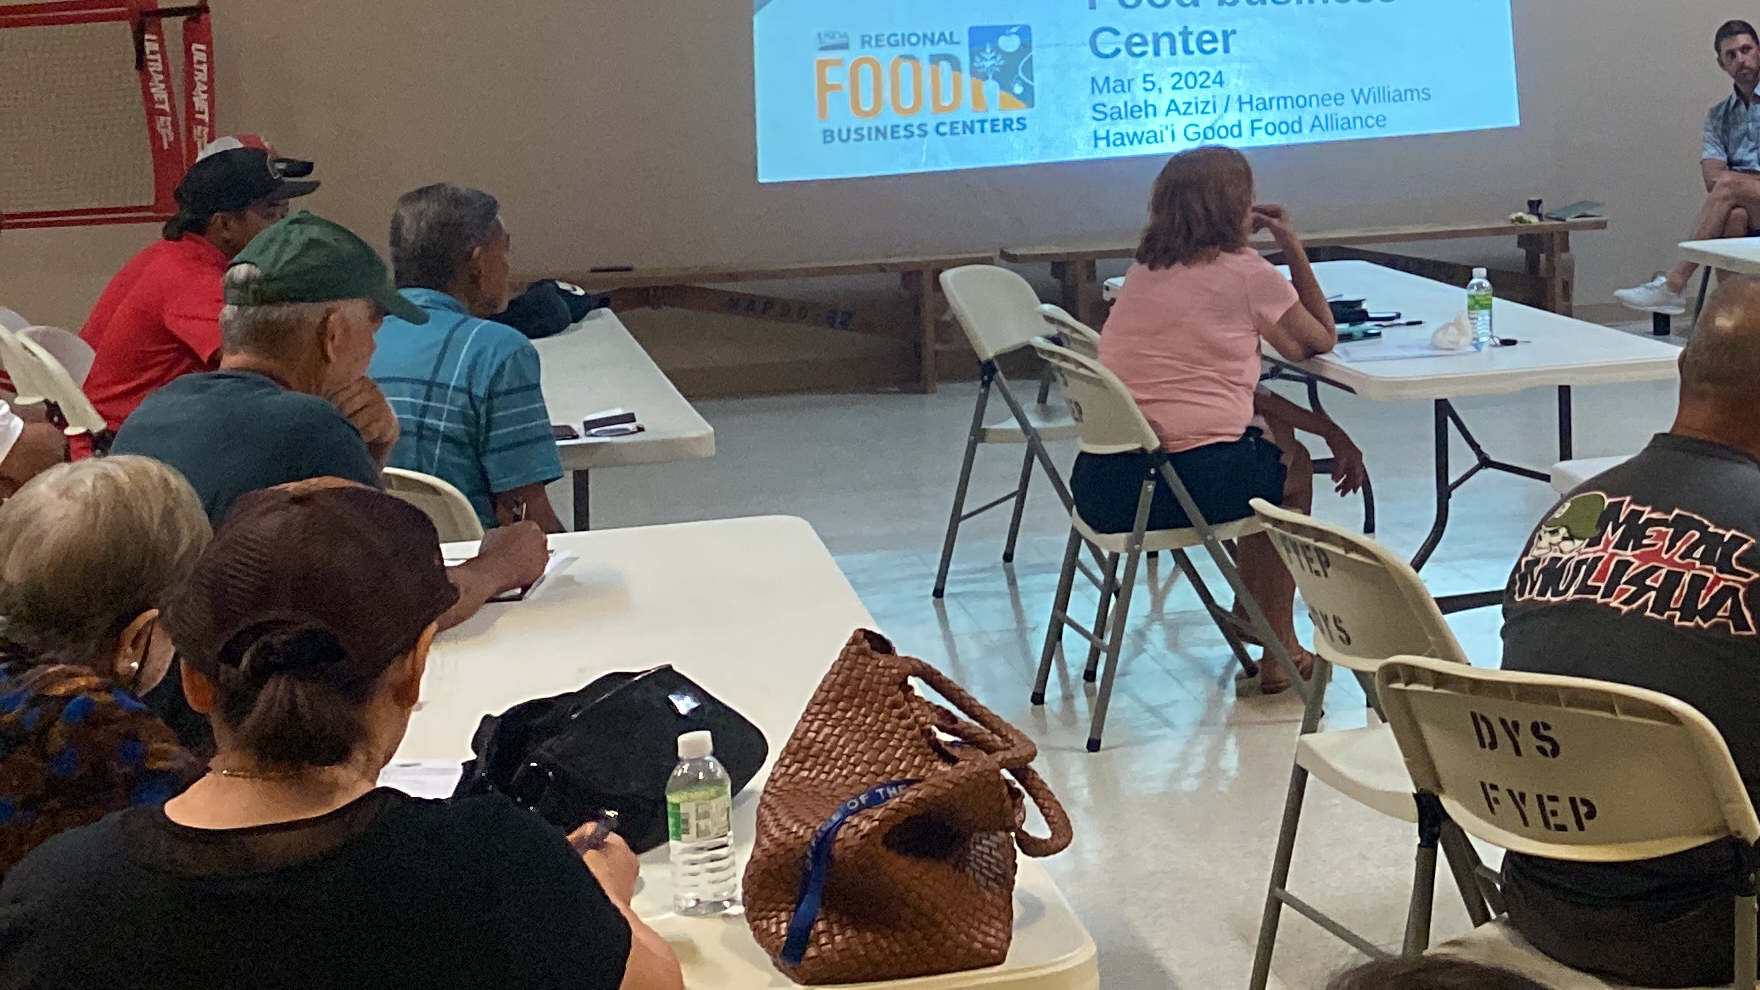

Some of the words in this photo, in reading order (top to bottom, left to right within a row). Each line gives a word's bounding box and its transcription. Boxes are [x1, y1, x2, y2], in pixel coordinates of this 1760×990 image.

[860, 31, 961, 49] REGIONAL
[1089, 25, 1237, 59] Center
[144, 33, 170, 112] ULTRANET
[191, 42, 209, 123] ULTRANET
[816, 53, 963, 120] FOOD
[1090, 76, 1136, 95] Mar
[1142, 73, 1163, 95] 5,
[1171, 71, 1226, 91] 2024
[1091, 99, 1157, 122] Saleh
[1165, 96, 1217, 117] Azizi
[1223, 96, 1231, 114] /
[1237, 89, 1345, 112] Harmonee
[1352, 85, 1432, 106] Williams
[822, 122, 929, 145] BUSINESS
[935, 116, 1027, 137] CENTERS
[1183, 120, 1243, 142] Good
[1251, 116, 1303, 139] Food
[1309, 111, 1387, 134] Alliance
[1584, 496, 1760, 580] METAL
[1470, 711, 1560, 758] DYS
[846, 793, 870, 810] OF
[1480, 780, 1597, 832] FYEP
